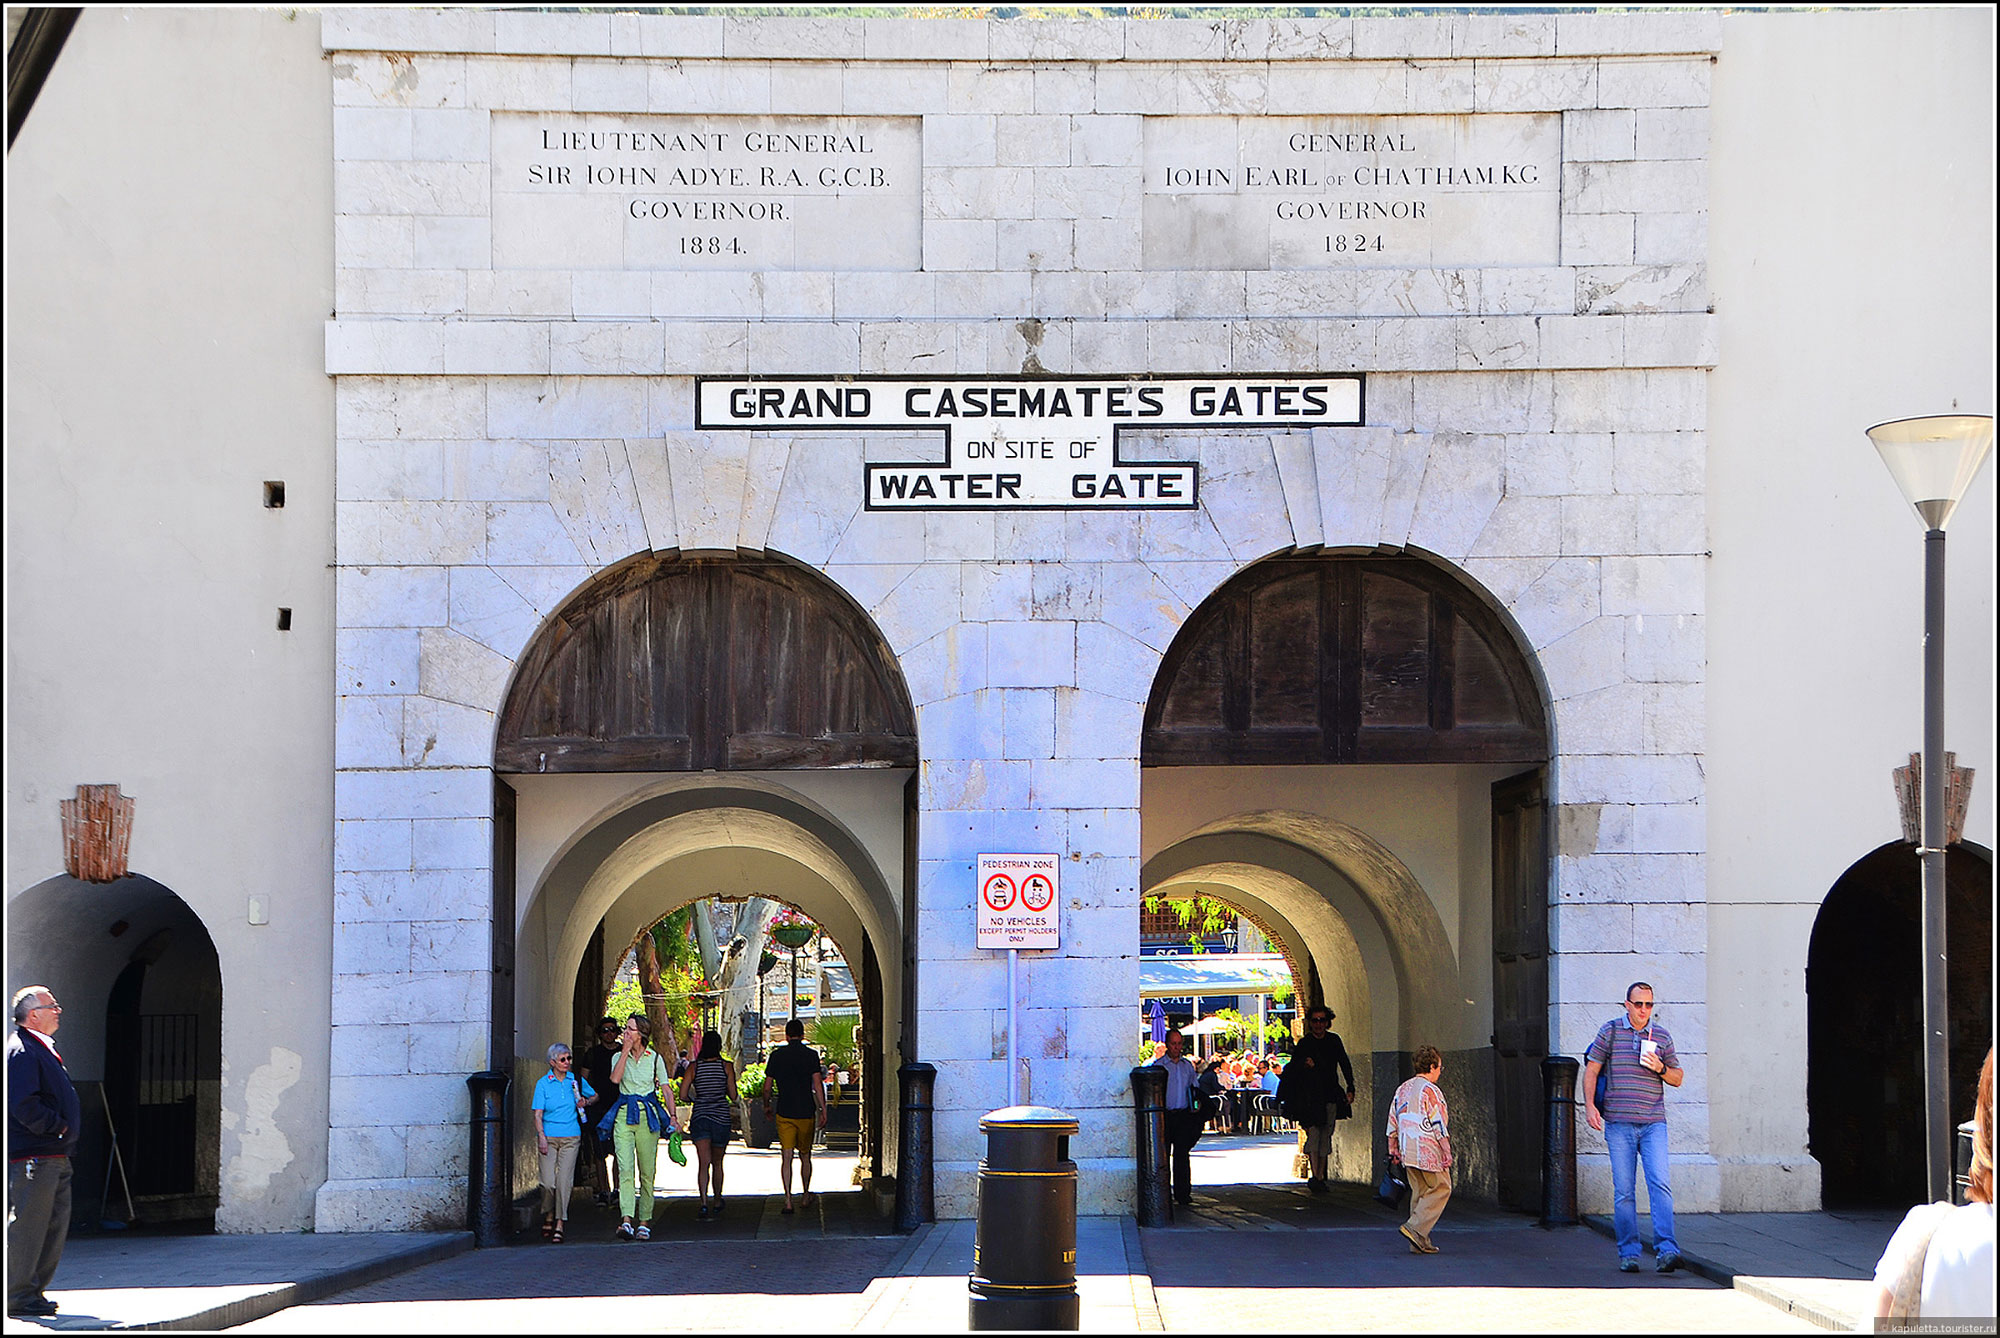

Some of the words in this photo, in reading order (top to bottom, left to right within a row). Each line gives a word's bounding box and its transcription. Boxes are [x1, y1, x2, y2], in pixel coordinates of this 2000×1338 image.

[542, 130, 729, 152] LIEUTENANT
[745, 132, 874, 153] GENERAL
[1289, 133, 1416, 153] GENERAL
[528, 165, 571, 185] SIR
[669, 167, 750, 188] ADYE.
[760, 168, 809, 188] R.A.
[818, 168, 890, 188] G.C.B.
[1246, 167, 1318, 187] EARL
[629, 200, 790, 221] GOVERNOR.
[1277, 200, 1426, 220] GOVERNOR
[680, 236, 748, 255] 1884.
[1325, 234, 1385, 253] 1824
[729, 388, 871, 418] GRAND
[905, 386, 1164, 418] CASEMATES
[1189, 386, 1329, 417] GATES
[967, 441, 999, 459] ON
[1005, 440, 1054, 459] SITE
[1069, 440, 1097, 459] OF
[880, 474, 1022, 499] WATER
[1072, 474, 1183, 498] GATE
[982, 860, 1031, 869] PEDESTRIAN
[1033, 861, 1054, 869] ZONE
[990, 917, 1004, 926] NO
[1007, 917, 1047, 926] VEHICLES
[1008, 935, 1025, 943] ONLY
